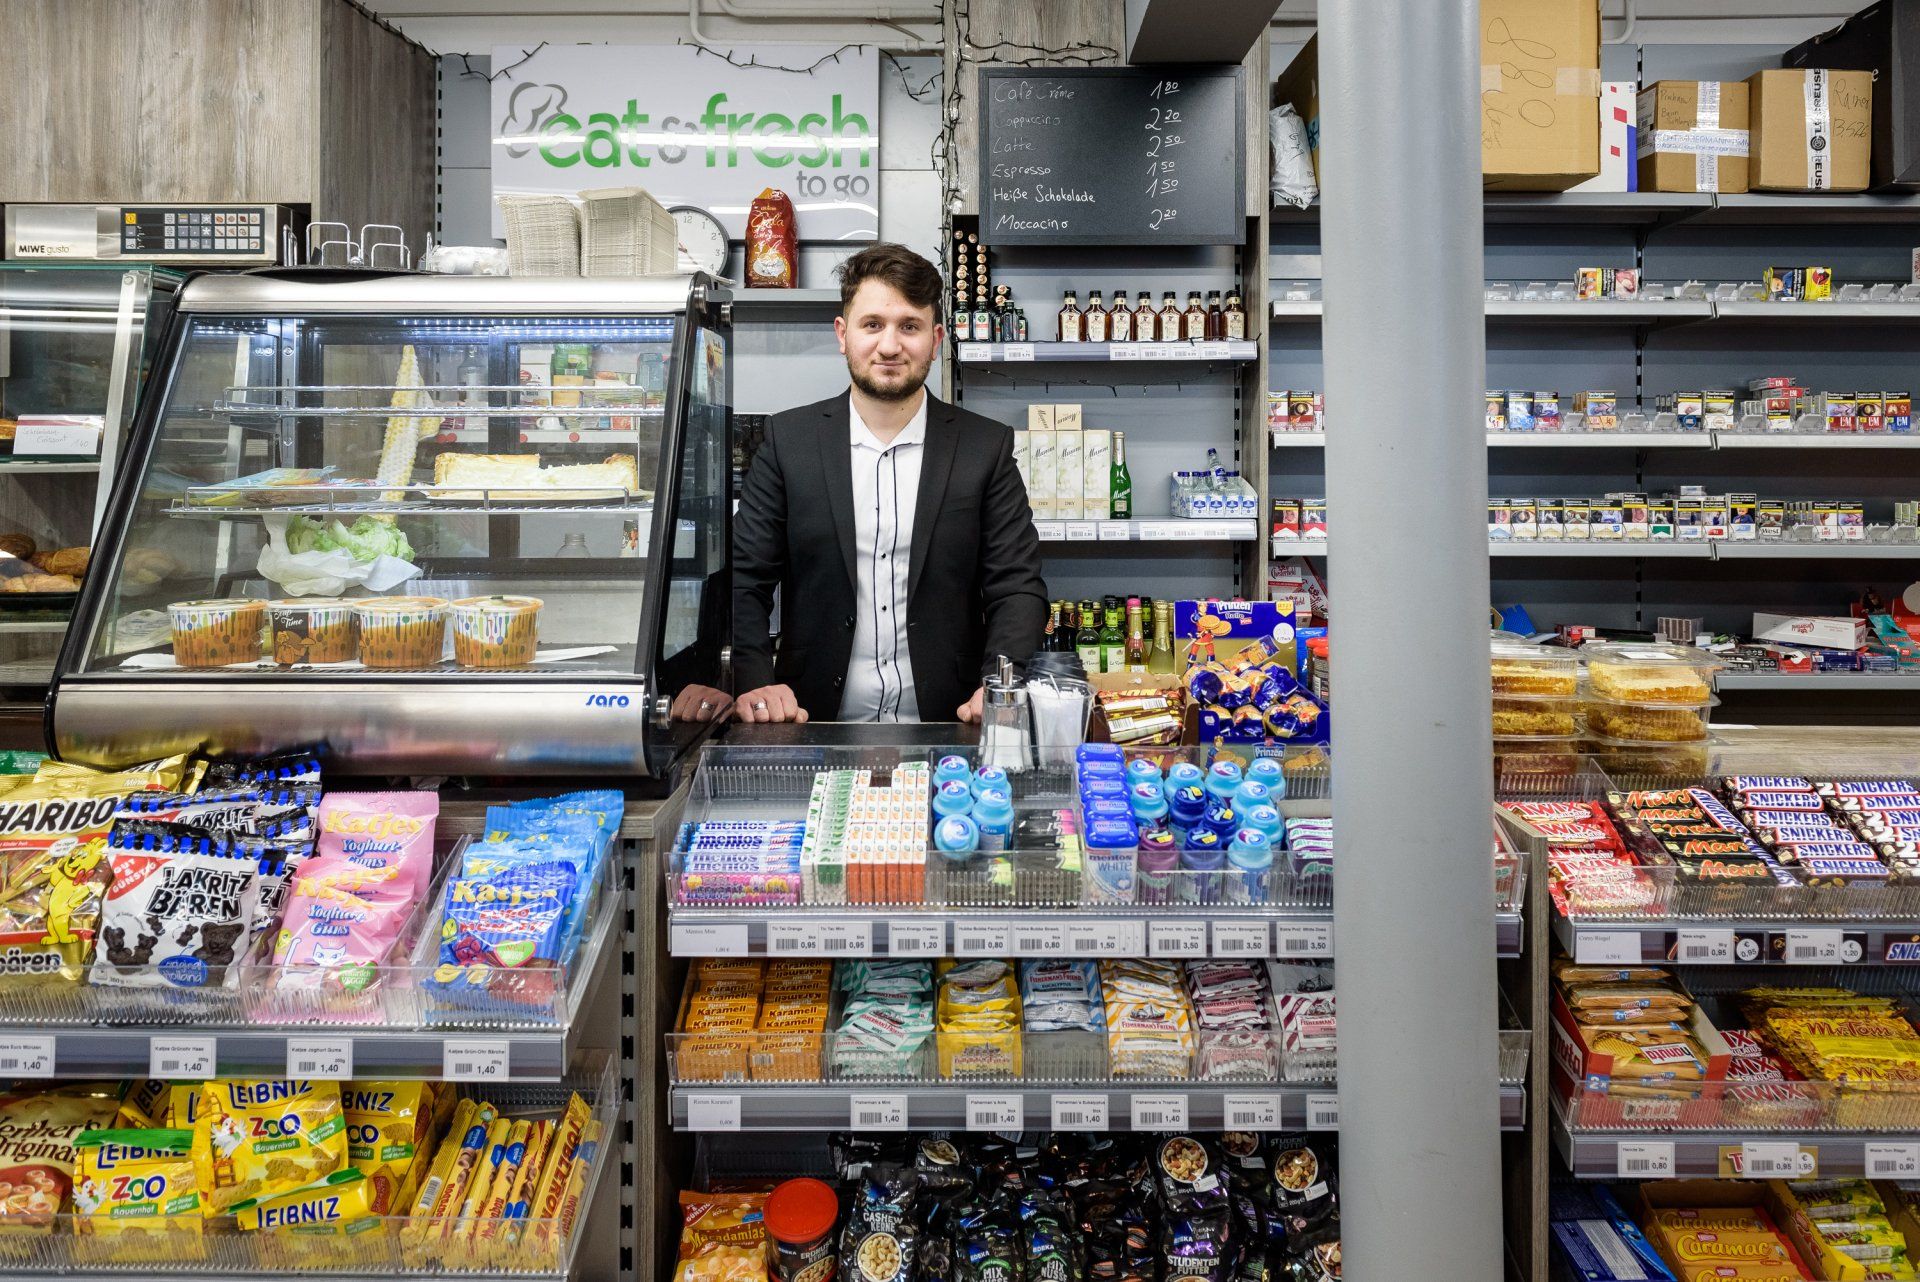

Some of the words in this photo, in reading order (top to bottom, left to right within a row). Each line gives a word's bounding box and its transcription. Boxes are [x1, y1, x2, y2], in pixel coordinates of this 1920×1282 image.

[994, 81, 1033, 102] Café
[538, 99, 652, 168] eat
[700, 93, 871, 168] fresh
[993, 136, 1036, 154] Latte
[992, 163, 1051, 179] Espresso
[796, 171, 827, 198] to
[833, 174, 870, 202] go
[993, 188, 1028, 202] Heiße
[1035, 184, 1096, 203] Schokolade
[995, 214, 1068, 231] Moccacino
[18, 245, 45, 253] MIWE
[47, 244, 70, 256] gusto
[1218, 601, 1251, 611] Prinzen
[281, 617, 303, 628] Time
[585, 694, 630, 708] saro
[1739, 777, 1810, 789] SNICKERS
[1818, 783, 1834, 795] 2
[1841, 781, 1916, 795] SNICKERS
[1627, 789, 1691, 808] Mars
[1750, 793, 1822, 807] SNICKERS
[1844, 798, 1859, 810] 2
[1866, 796, 1920, 807] SNICKE
[0, 797, 119, 834] HARIBO
[1638, 808, 1703, 824] Mars
[1759, 812, 1831, 826] SNICKERS
[325, 811, 423, 838] Katjes
[705, 821, 768, 830] mentos
[700, 835, 763, 845] mentos
[1780, 827, 1852, 842] SNICKERS
[1800, 844, 1872, 857] SNICKERS
[114, 858, 136, 875] GUT
[124, 867, 134, 876] &
[693, 863, 760, 871] mentos
[1099, 862, 1132, 872] WHITE
[1699, 859, 1769, 879] Mars
[1812, 861, 1889, 875] SNICKERS
[112, 862, 158, 893] GÜNSTIG
[163, 867, 252, 896] LAKRITZ
[147, 887, 242, 921] BÄREN
[310, 923, 350, 936] Gums
[801, 941, 816, 949] 0,95
[849, 941, 865, 949] 0,95
[922, 941, 938, 949] 1,20
[987, 941, 1003, 949] 0,80
[1044, 941, 1060, 949] 0,80
[1099, 942, 1115, 950] 1,50
[1183, 942, 1199, 950] 3,50
[1246, 942, 1262, 950] 3,50
[1310, 942, 1326, 950] 3,50
[1741, 949, 1756, 958] 0,95
[704, 961, 752, 971] Karamell
[776, 961, 822, 970] Karamell
[773, 983, 819, 991] Karamell
[697, 1006, 746, 1015] Karamell
[769, 1007, 817, 1017] Karamell
[693, 1019, 743, 1027] Karamell
[766, 1018, 814, 1027] Karamell
[23, 1062, 41, 1071] 1,40
[184, 1063, 202, 1072] 1,40
[320, 1064, 339, 1073] 1,40
[477, 1066, 495, 1075] 1,40
[228, 1081, 313, 1109] LEIBNIZ
[342, 1091, 394, 1111] BNIZ
[250, 1114, 301, 1138] ZOO
[255, 1140, 297, 1152] Bauernhof
[97, 1144, 187, 1169] LEIBNIZ
[1652, 1162, 1667, 1170] 0,80
[111, 1175, 166, 1201] ZOO
[113, 1204, 154, 1216] Bauernhof
[863, 1212, 903, 1224] CASHEW
[871, 1222, 896, 1232] KERNE
[690, 1228, 765, 1250] Macadamias
[1033, 1245, 1054, 1253] EDEKA
[1677, 1235, 1772, 1262] Caramac
[1167, 1255, 1219, 1266] STUDENTEN
[1047, 1260, 1064, 1274] MIX
[1178, 1266, 1209, 1275] FUTTER
[983, 1267, 1003, 1280] MIX
